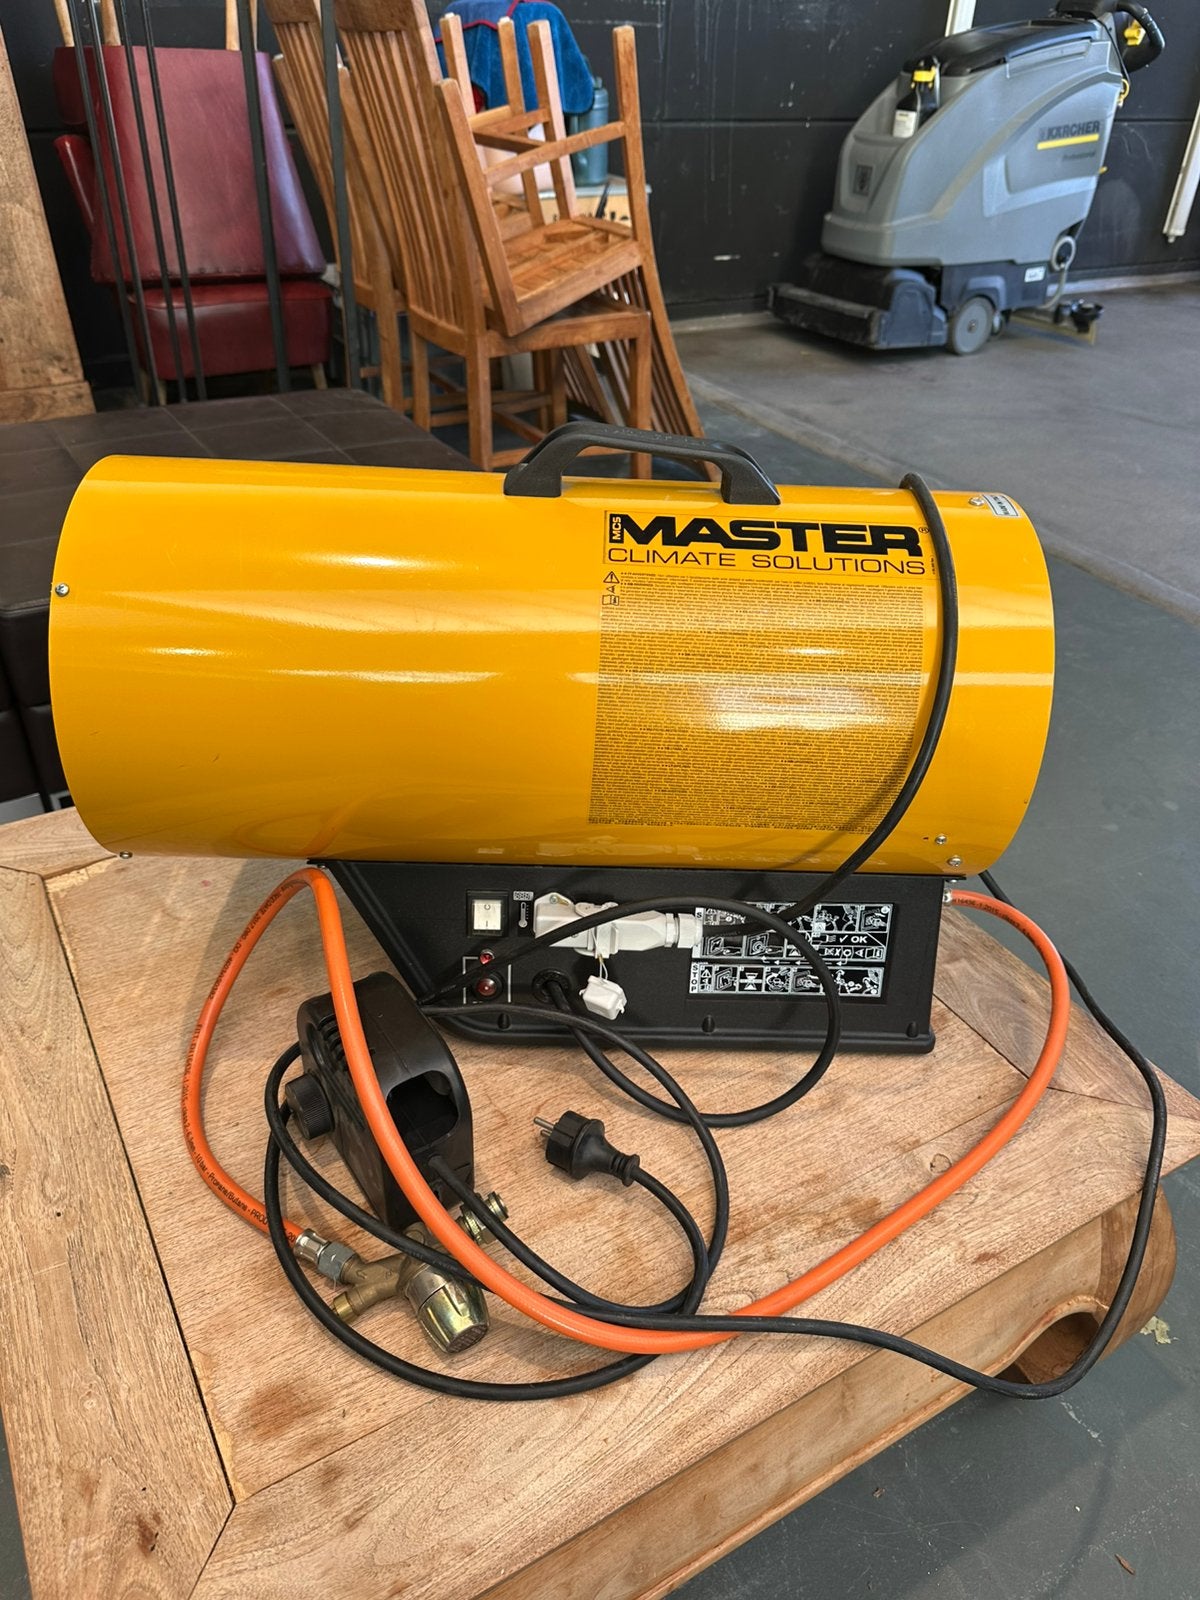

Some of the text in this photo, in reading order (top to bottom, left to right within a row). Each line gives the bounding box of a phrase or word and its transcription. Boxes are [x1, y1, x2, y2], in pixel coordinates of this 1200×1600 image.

[612, 516, 622, 541] MCS
[622, 514, 923, 557] MASTER
[608, 548, 736, 567] CLIMATE
[752, 554, 925, 575] SOLUTIONS
[851, 935, 868, 944] OK
